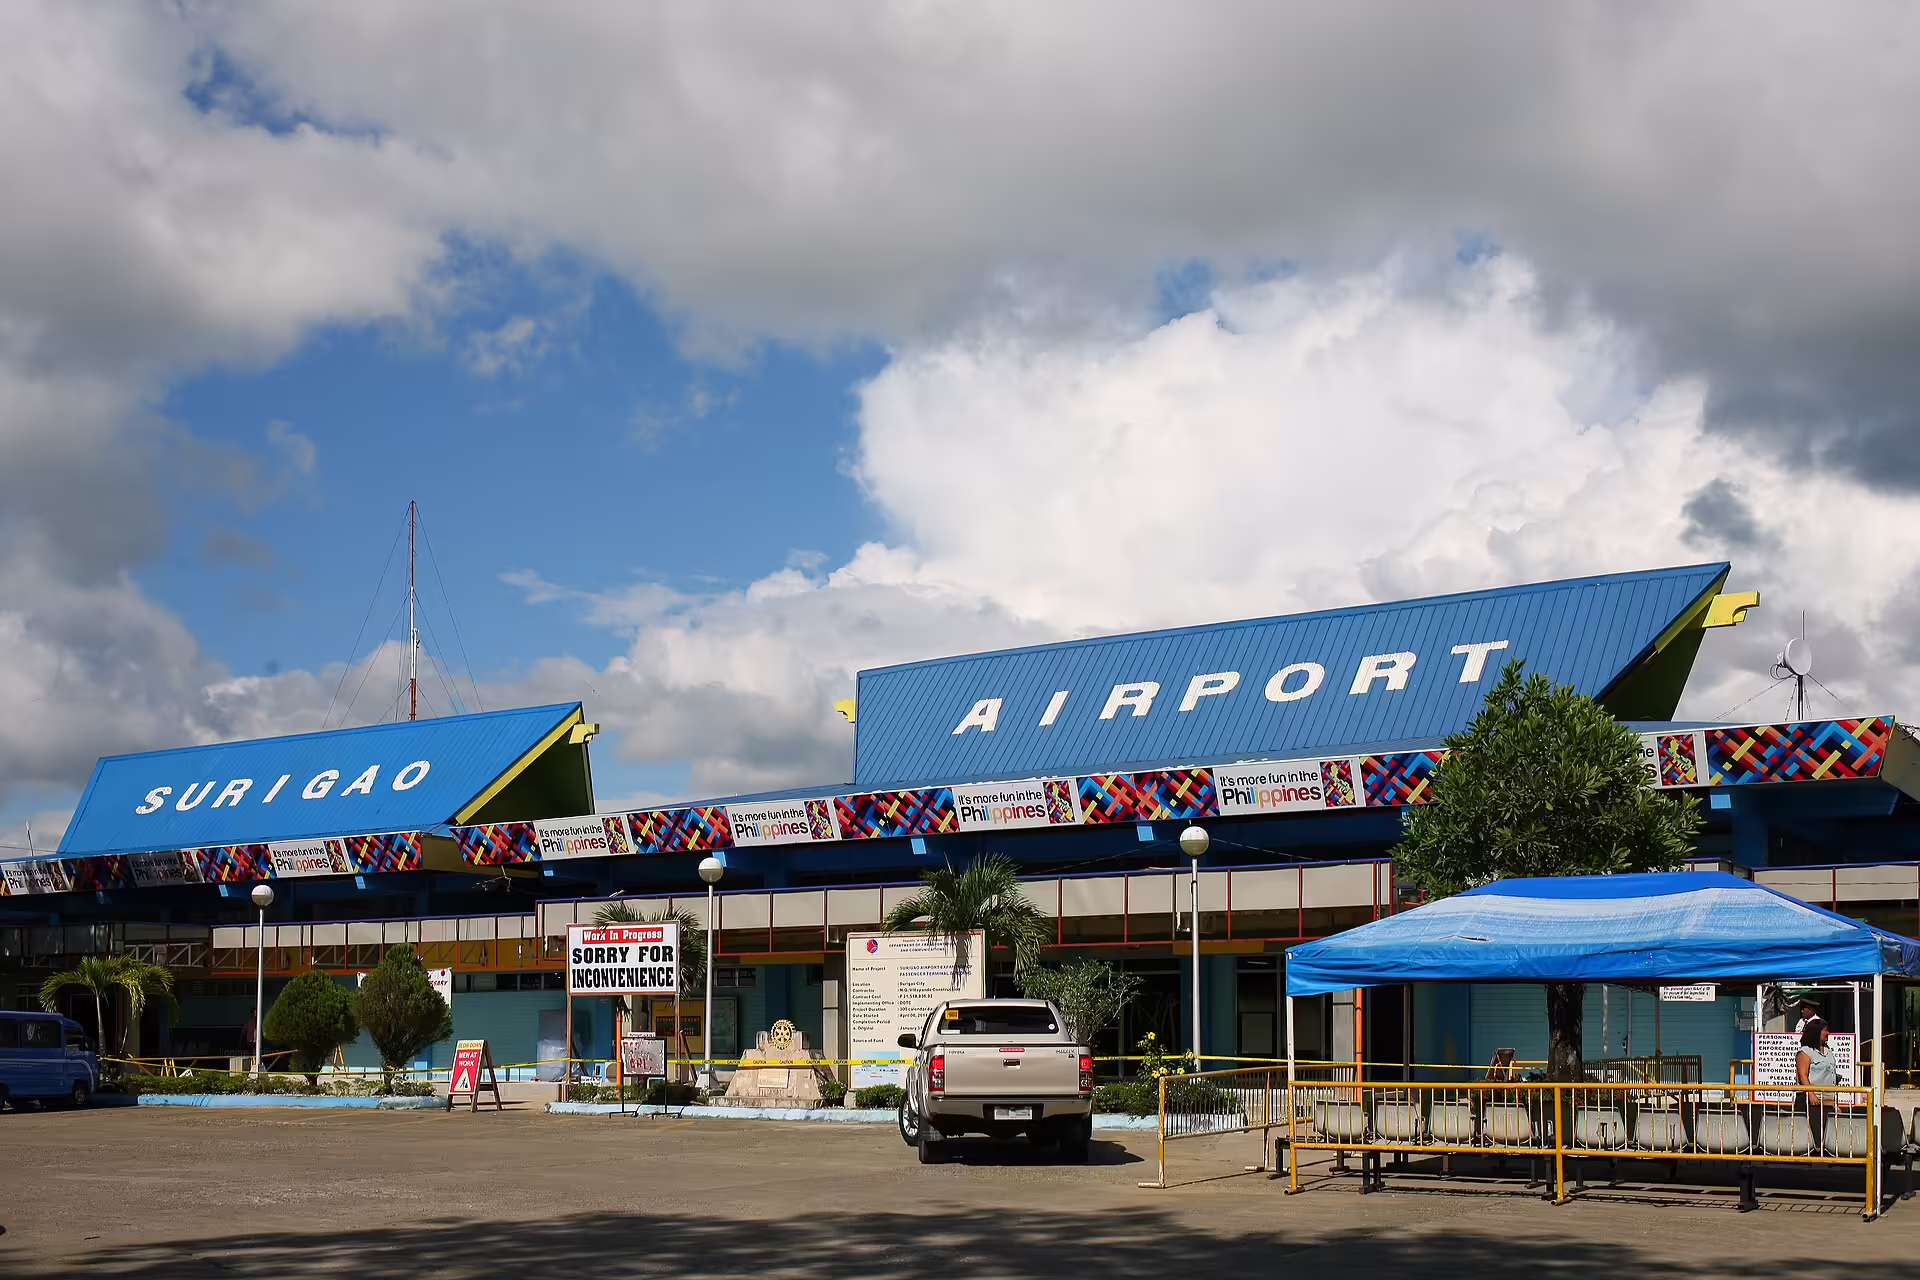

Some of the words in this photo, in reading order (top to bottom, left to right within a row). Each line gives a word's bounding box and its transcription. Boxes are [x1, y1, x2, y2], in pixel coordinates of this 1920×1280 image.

[950, 638, 1511, 738] AIRPORT
[134, 759, 432, 815] SURIGAO
[1219, 776, 1234, 787] It's
[1236, 774, 1267, 786] more
[1268, 772, 1286, 784] fun
[1288, 772, 1298, 783] in
[1299, 770, 1318, 782] the
[958, 794, 971, 805] It's
[973, 793, 999, 804] more
[1000, 792, 1016, 802] fun
[1016, 790, 1026, 801] in
[1026, 790, 1042, 800] the
[1222, 784, 1322, 808] Philippines
[732, 813, 743, 823] It's
[744, 812, 767, 822] more
[768, 810, 781, 820] fun
[781, 809, 790, 819] in
[790, 808, 804, 818] the
[960, 803, 1046, 824] Philippines
[539, 828, 549, 838] It's
[550, 827, 570, 837] more
[570, 826, 582, 835] fun
[582, 826, 589, 834] in
[589, 825, 602, 834] the
[734, 821, 808, 840] Philippines
[282, 849, 298, 857] more
[542, 836, 607, 855] Philippines
[275, 856, 329, 873] Philippines
[584, 930, 606, 941] Work
[610, 930, 618, 940] In
[622, 930, 662, 942] Progress
[572, 946, 630, 964] SORRY
[638, 945, 674, 962] FOR
[572, 967, 674, 988] INCONVENIENCE
